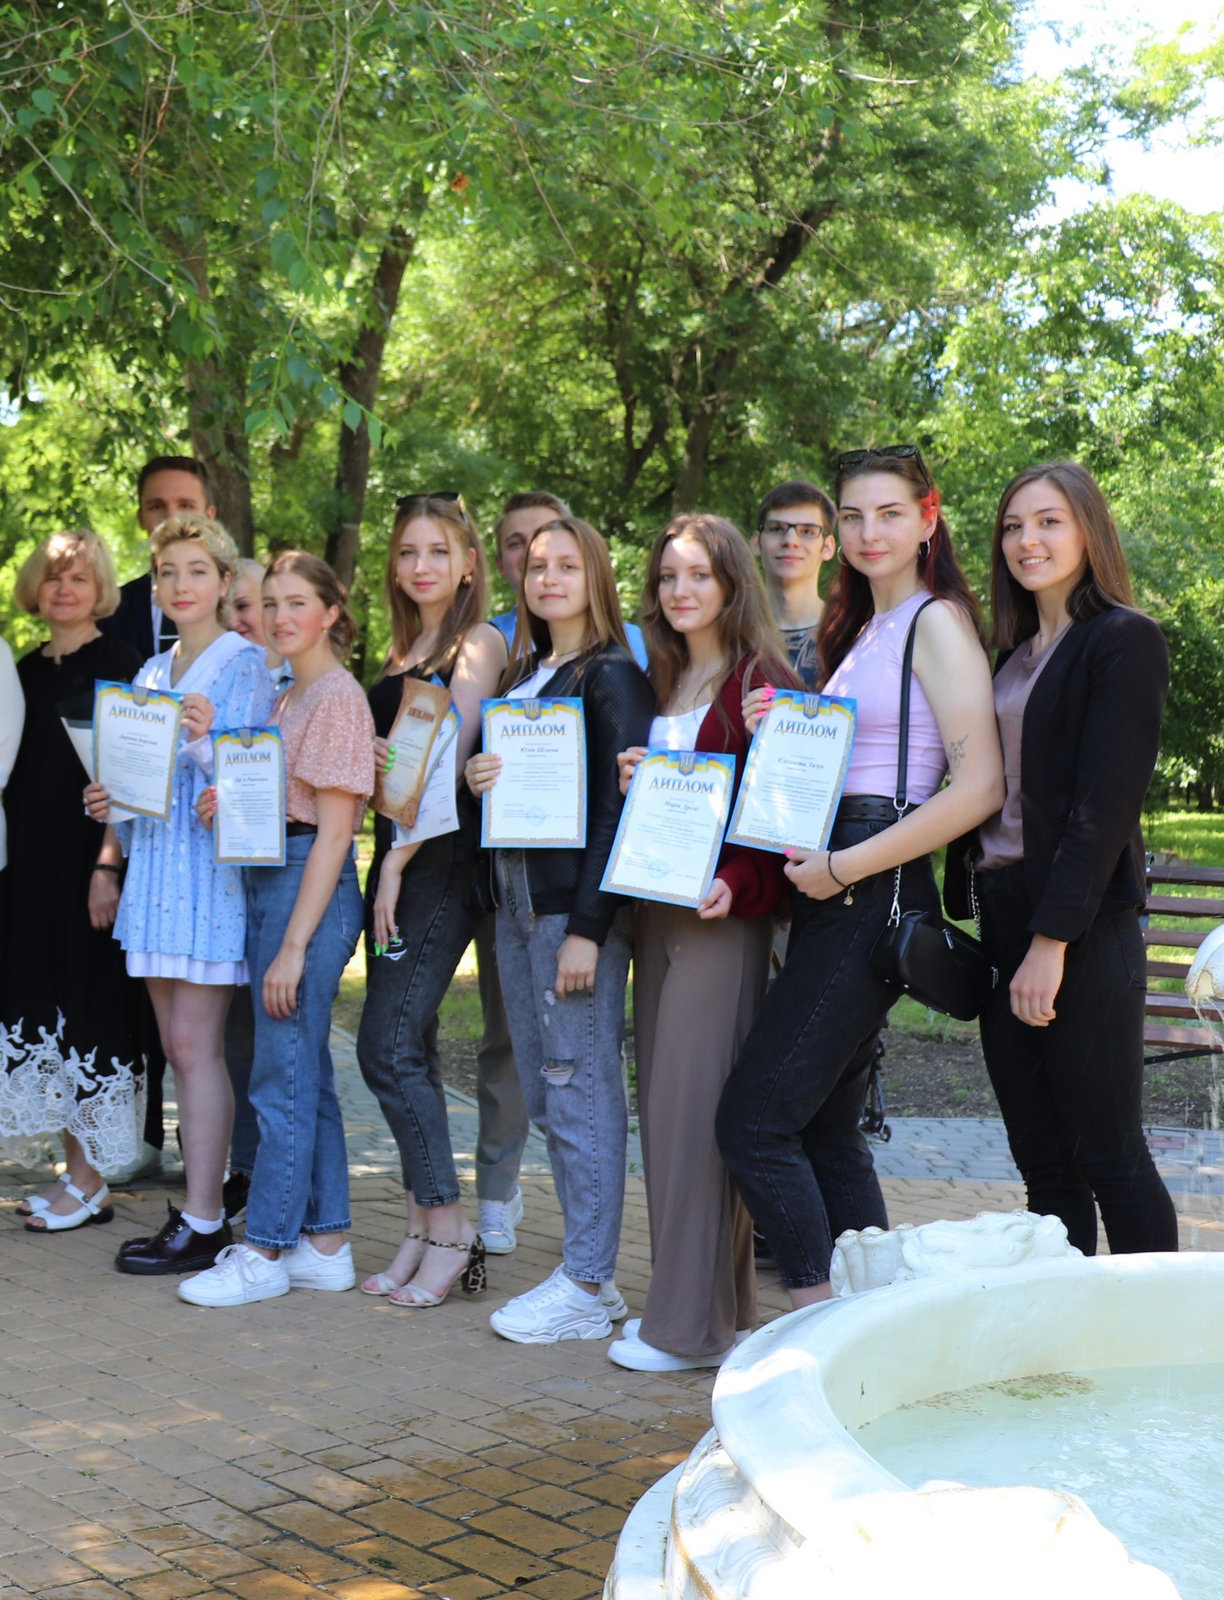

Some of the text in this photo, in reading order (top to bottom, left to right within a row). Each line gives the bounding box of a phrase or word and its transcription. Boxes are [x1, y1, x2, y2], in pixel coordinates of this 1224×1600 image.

[108, 704, 167, 725] ДИПЛОМ
[500, 723, 567, 740] ДИПЛОМ
[773, 719, 839, 740] ДИПЛОМ
[224, 752, 272, 767] ДИПЛОМ
[648, 776, 715, 794] ДИПЛОМ
